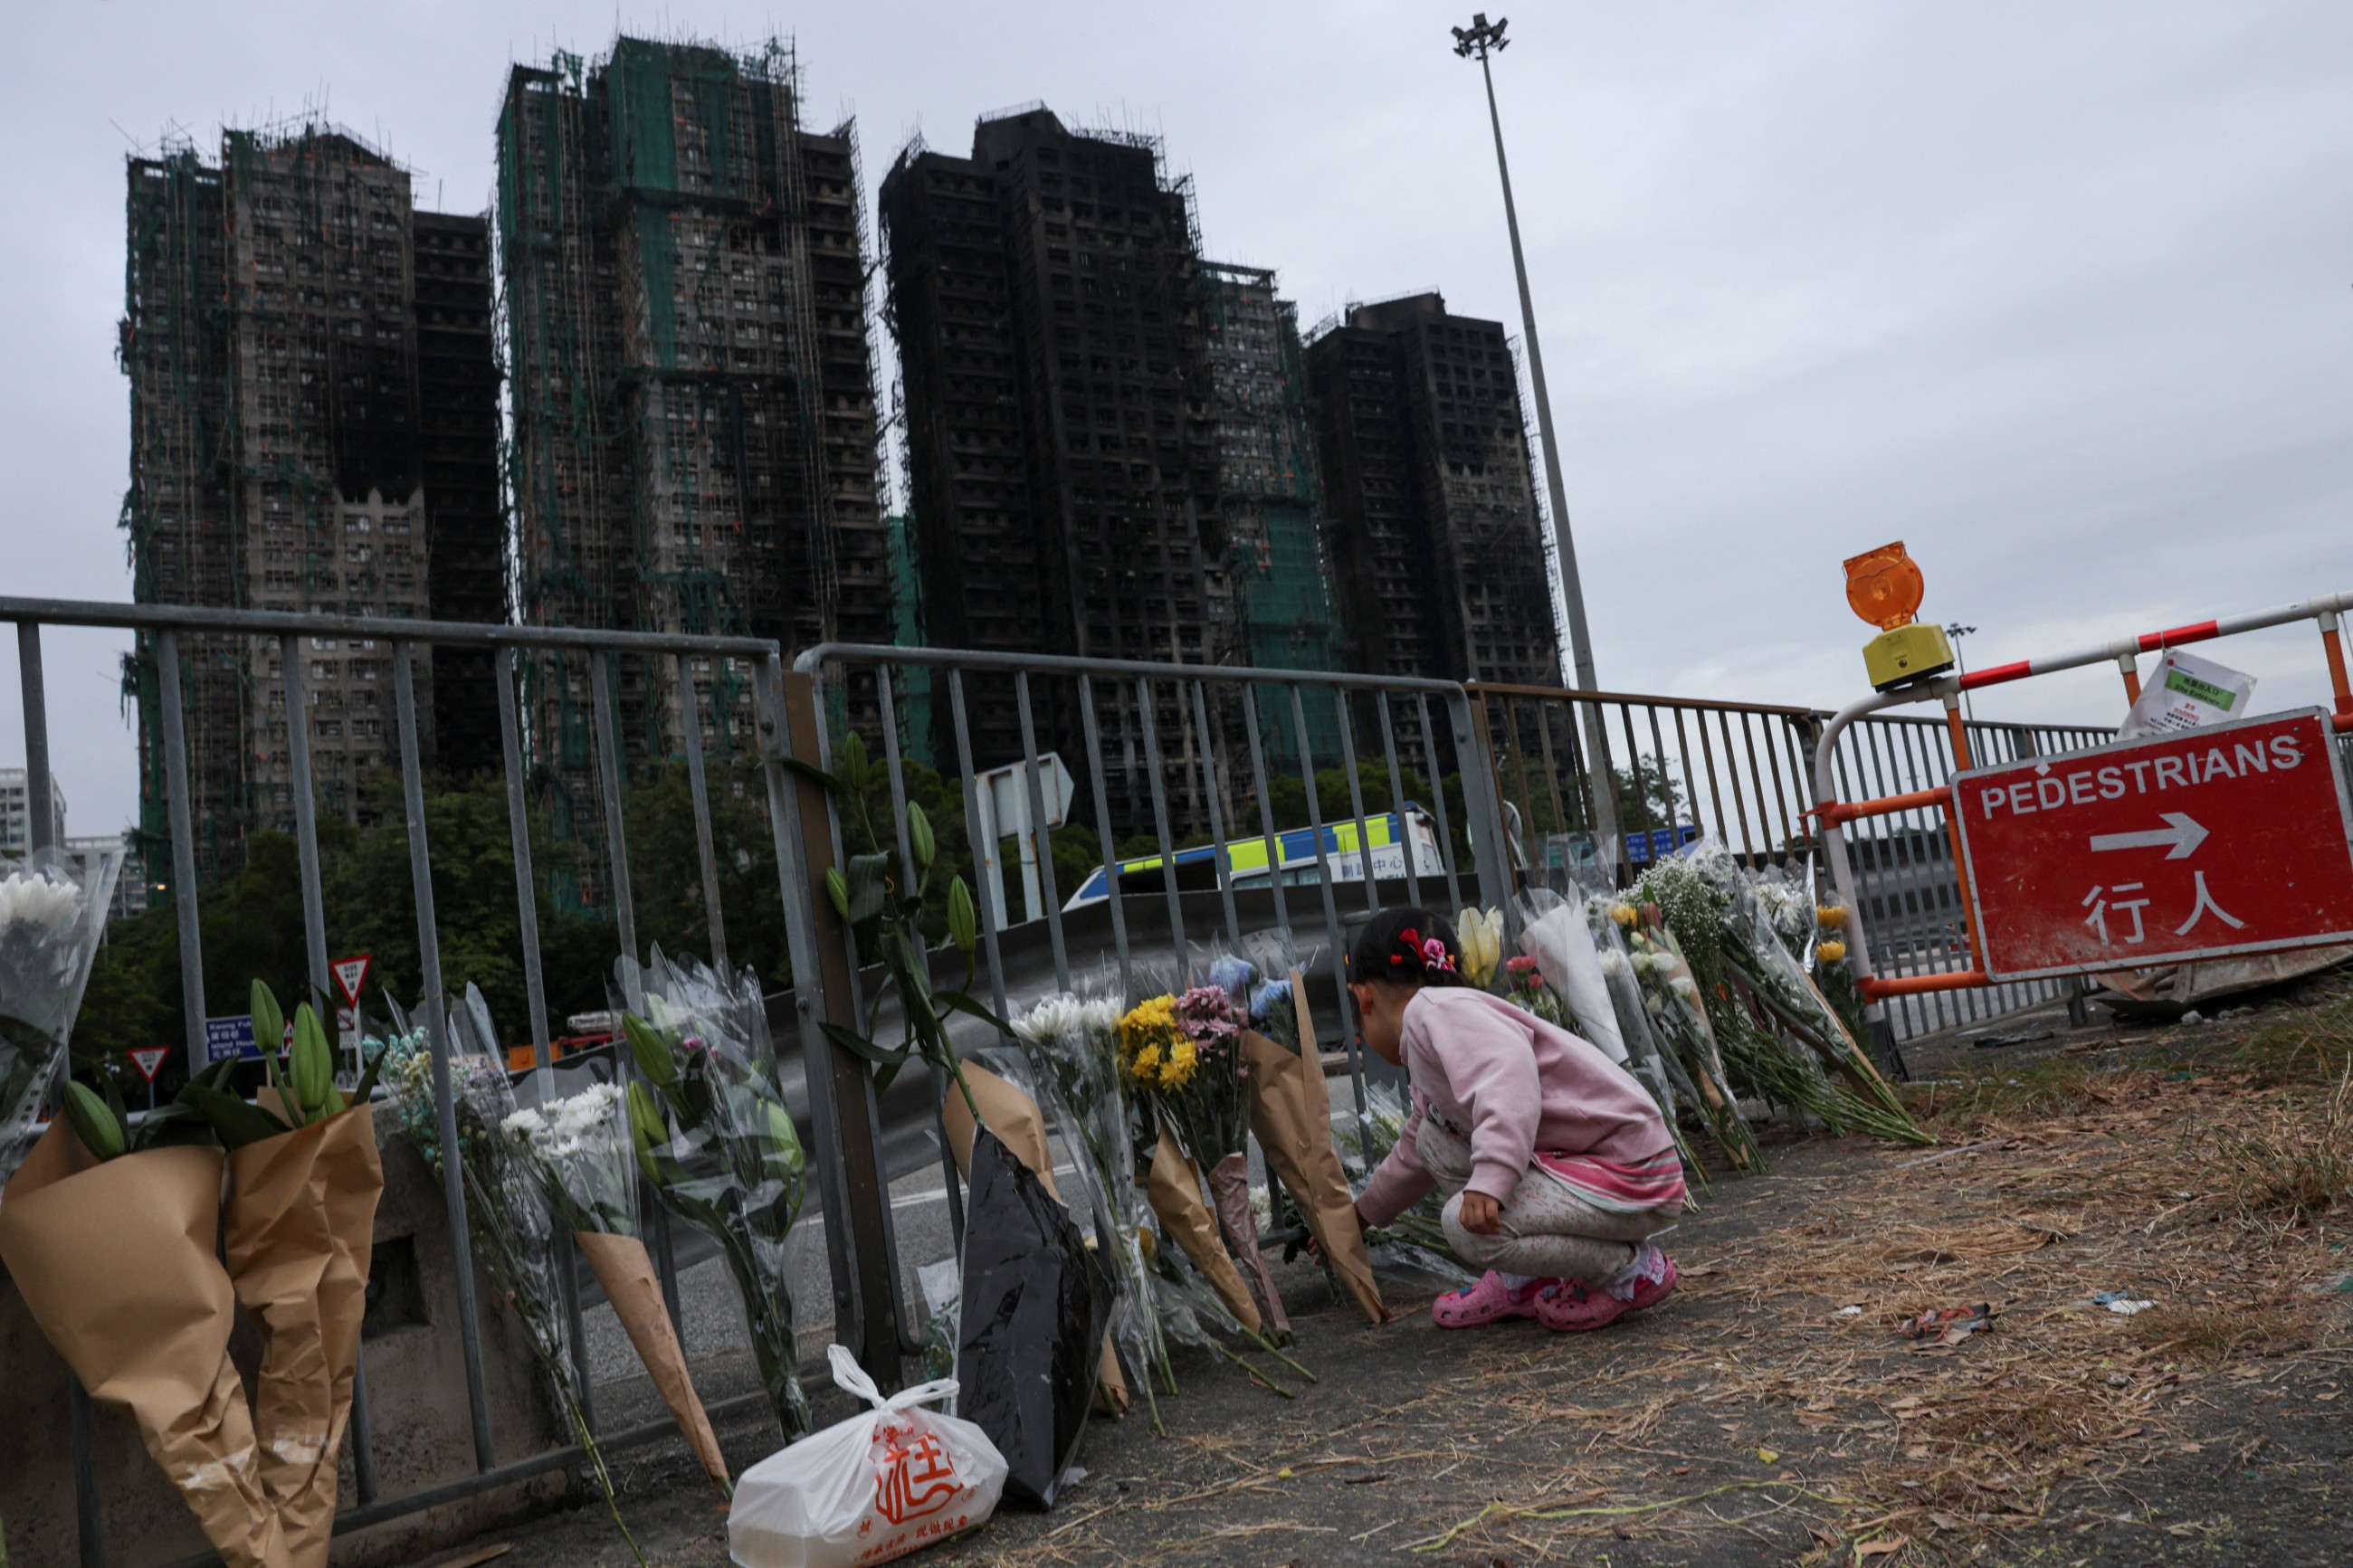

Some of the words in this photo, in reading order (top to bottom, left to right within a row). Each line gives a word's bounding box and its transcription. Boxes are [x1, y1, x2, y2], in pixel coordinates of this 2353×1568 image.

[2175, 684, 2188, 694] Site
[2189, 689, 2220, 706] Entrance
[2173, 707, 2200, 722] WARNING
[1980, 735, 2305, 820] PEDESTRIANS
[2082, 870, 2244, 946] 行人
[344, 964, 357, 973] GIVE
[345, 972, 357, 980] WAY
